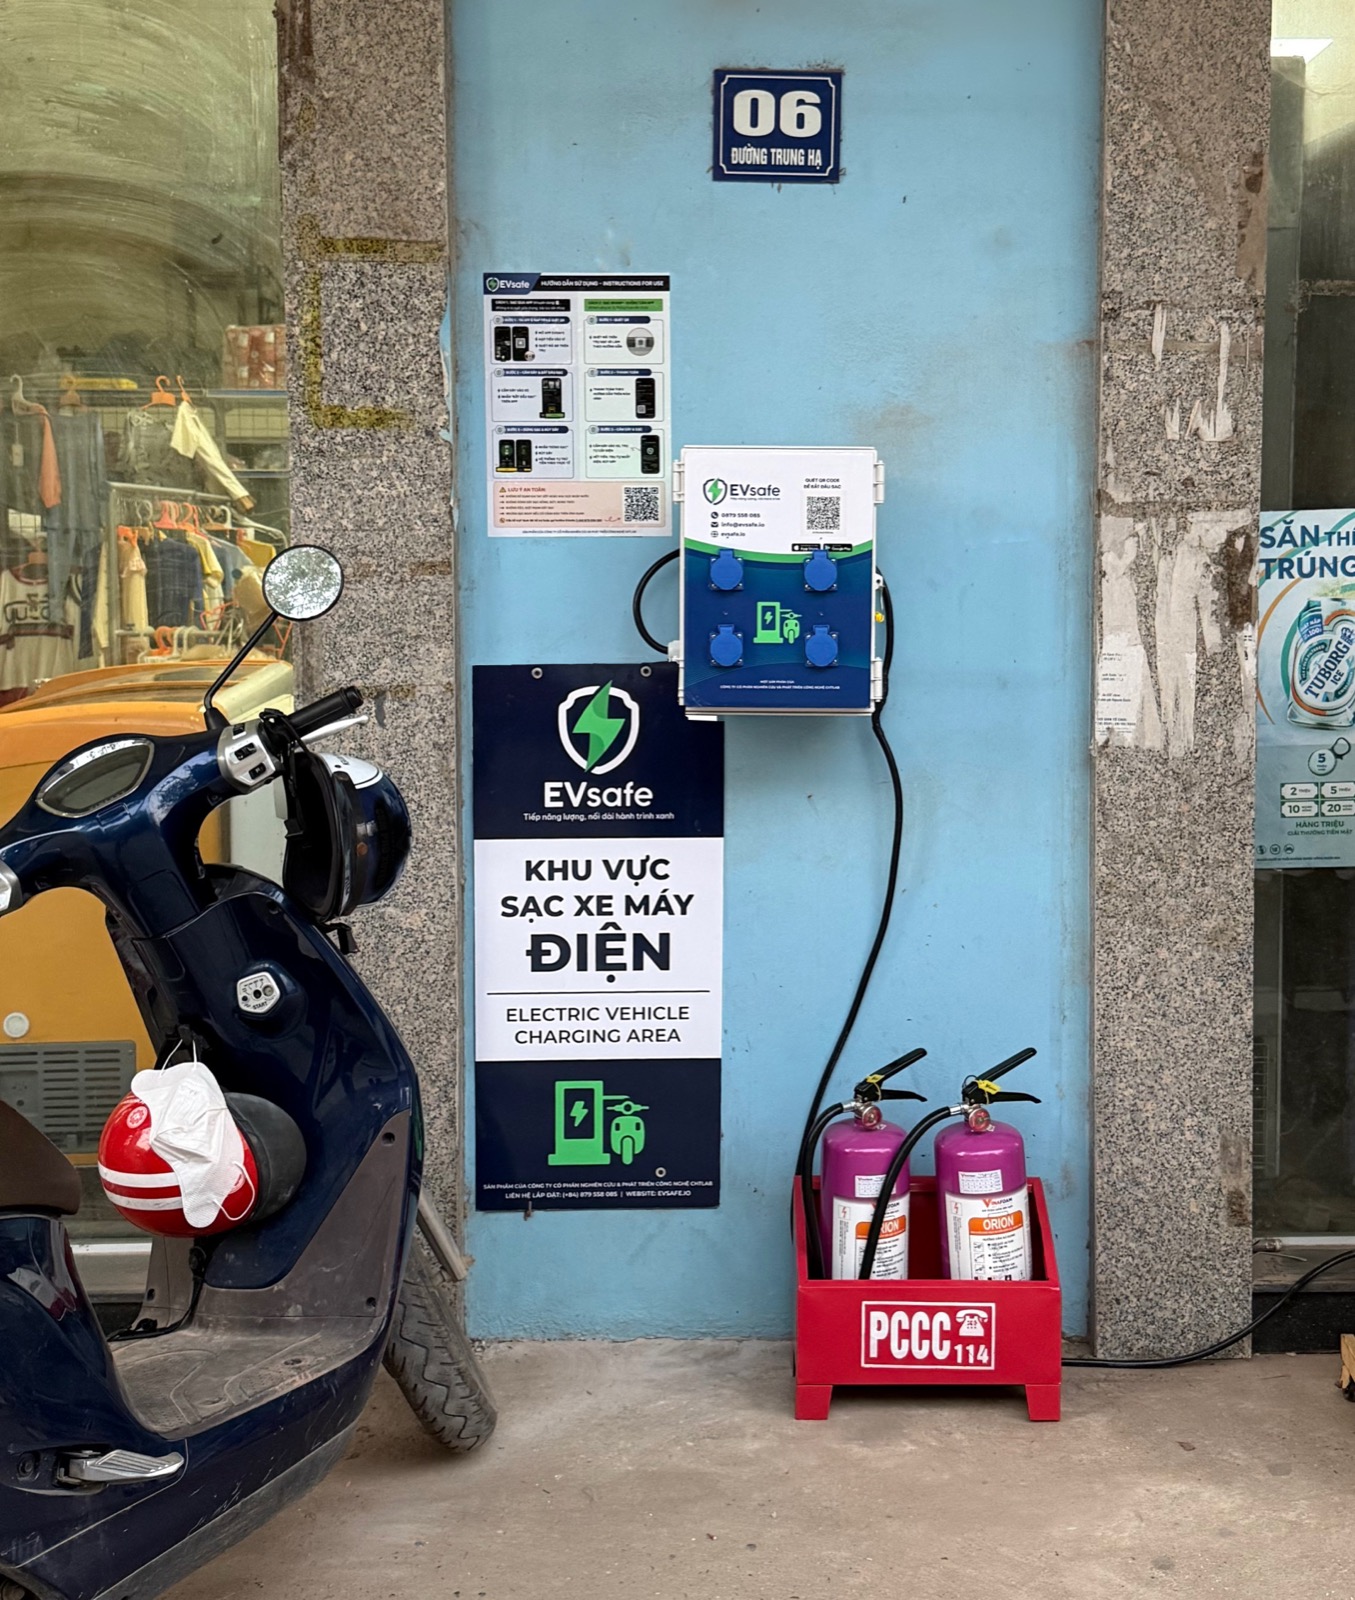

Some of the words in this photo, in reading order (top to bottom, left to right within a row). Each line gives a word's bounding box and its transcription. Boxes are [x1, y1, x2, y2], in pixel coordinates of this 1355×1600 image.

[734, 90, 821, 137] 06
[731, 144, 768, 164] ĐƯỜNG
[770, 148, 804, 166] TRUNG
[808, 149, 822, 170] HẠ
[500, 280, 530, 288] EVsafe
[730, 484, 780, 496] EVsafe
[1260, 519, 1319, 548] SĂN
[1259, 551, 1355, 579] TRÚNG
[1304, 640, 1350, 699] TUBORG
[1330, 669, 1344, 685] ICE
[1318, 753, 1326, 763] 5
[544, 781, 653, 807] EVsafe
[1290, 787, 1297, 796] 2
[1330, 786, 1337, 794] 5
[1288, 805, 1300, 813] 10
[1328, 804, 1341, 812] 20
[524, 813, 540, 821] Tiếp
[542, 814, 561, 822] năng
[563, 813, 586, 822] lượng,
[616, 812, 634, 820] hành
[1321, 820, 1344, 828] TRIỆU
[525, 859, 592, 882] KHU
[602, 854, 670, 886] VỰC
[501, 895, 564, 923] SẠC
[574, 894, 614, 916] XE
[625, 888, 694, 916] MÁY
[526, 922, 670, 983] ĐIỆN
[506, 1008, 600, 1022] ELECTRIC
[606, 1006, 690, 1020] VEHICLE
[515, 1029, 621, 1044] CHARGING
[626, 1028, 681, 1042] AREA
[880, 1219, 899, 1235] RION
[983, 1216, 1014, 1230] ORION
[870, 1311, 951, 1359] PCCC
[954, 1344, 989, 1364] 114
